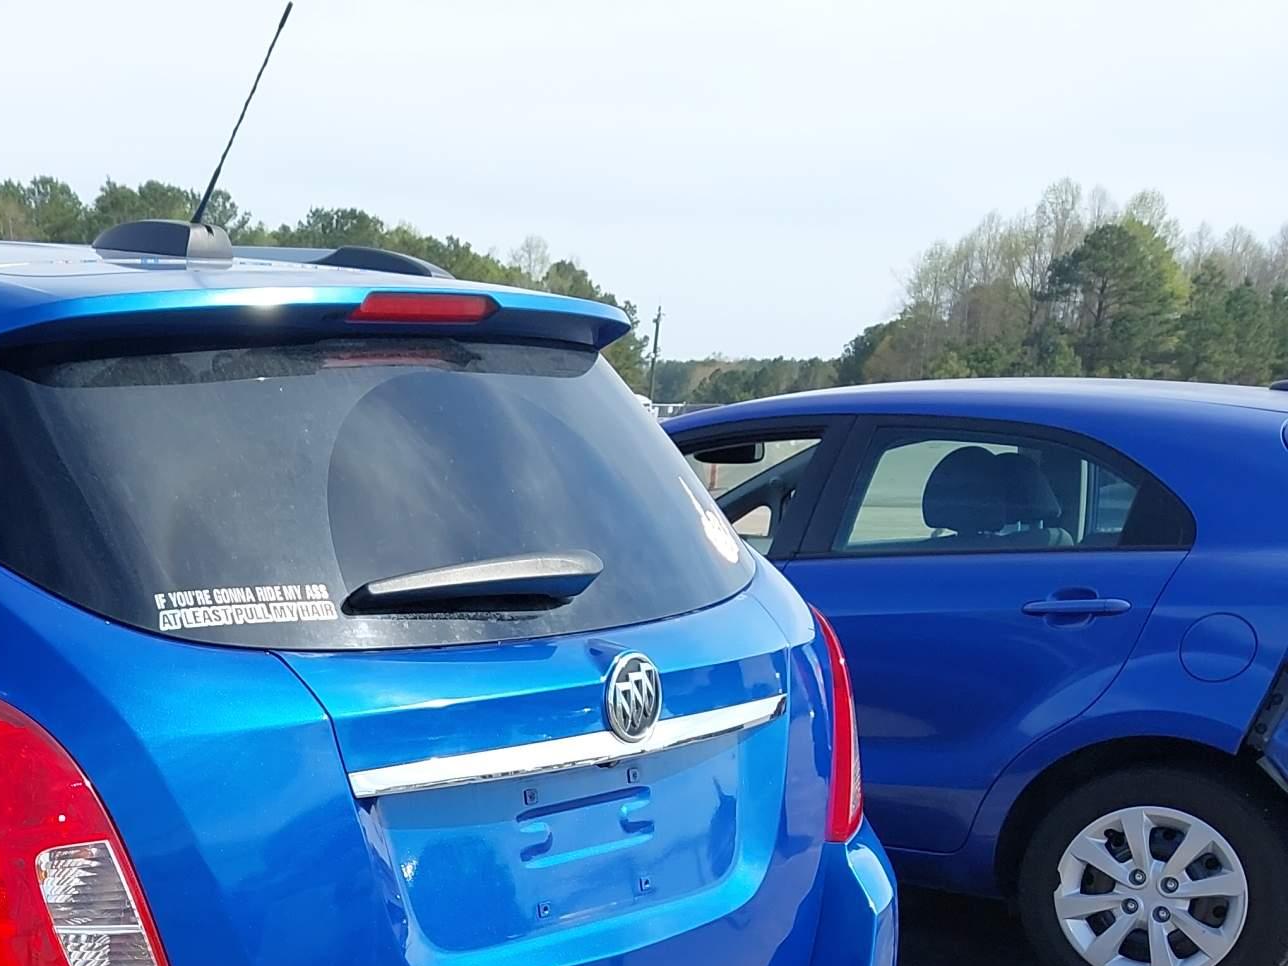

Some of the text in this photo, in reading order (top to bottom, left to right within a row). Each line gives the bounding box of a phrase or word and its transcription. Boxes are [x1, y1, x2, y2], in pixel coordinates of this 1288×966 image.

[154, 583, 329, 610] IF YOU'RE GONNA RIDE MY ASS
[161, 602, 336, 629] AT LEAST PULL MY HAIR
